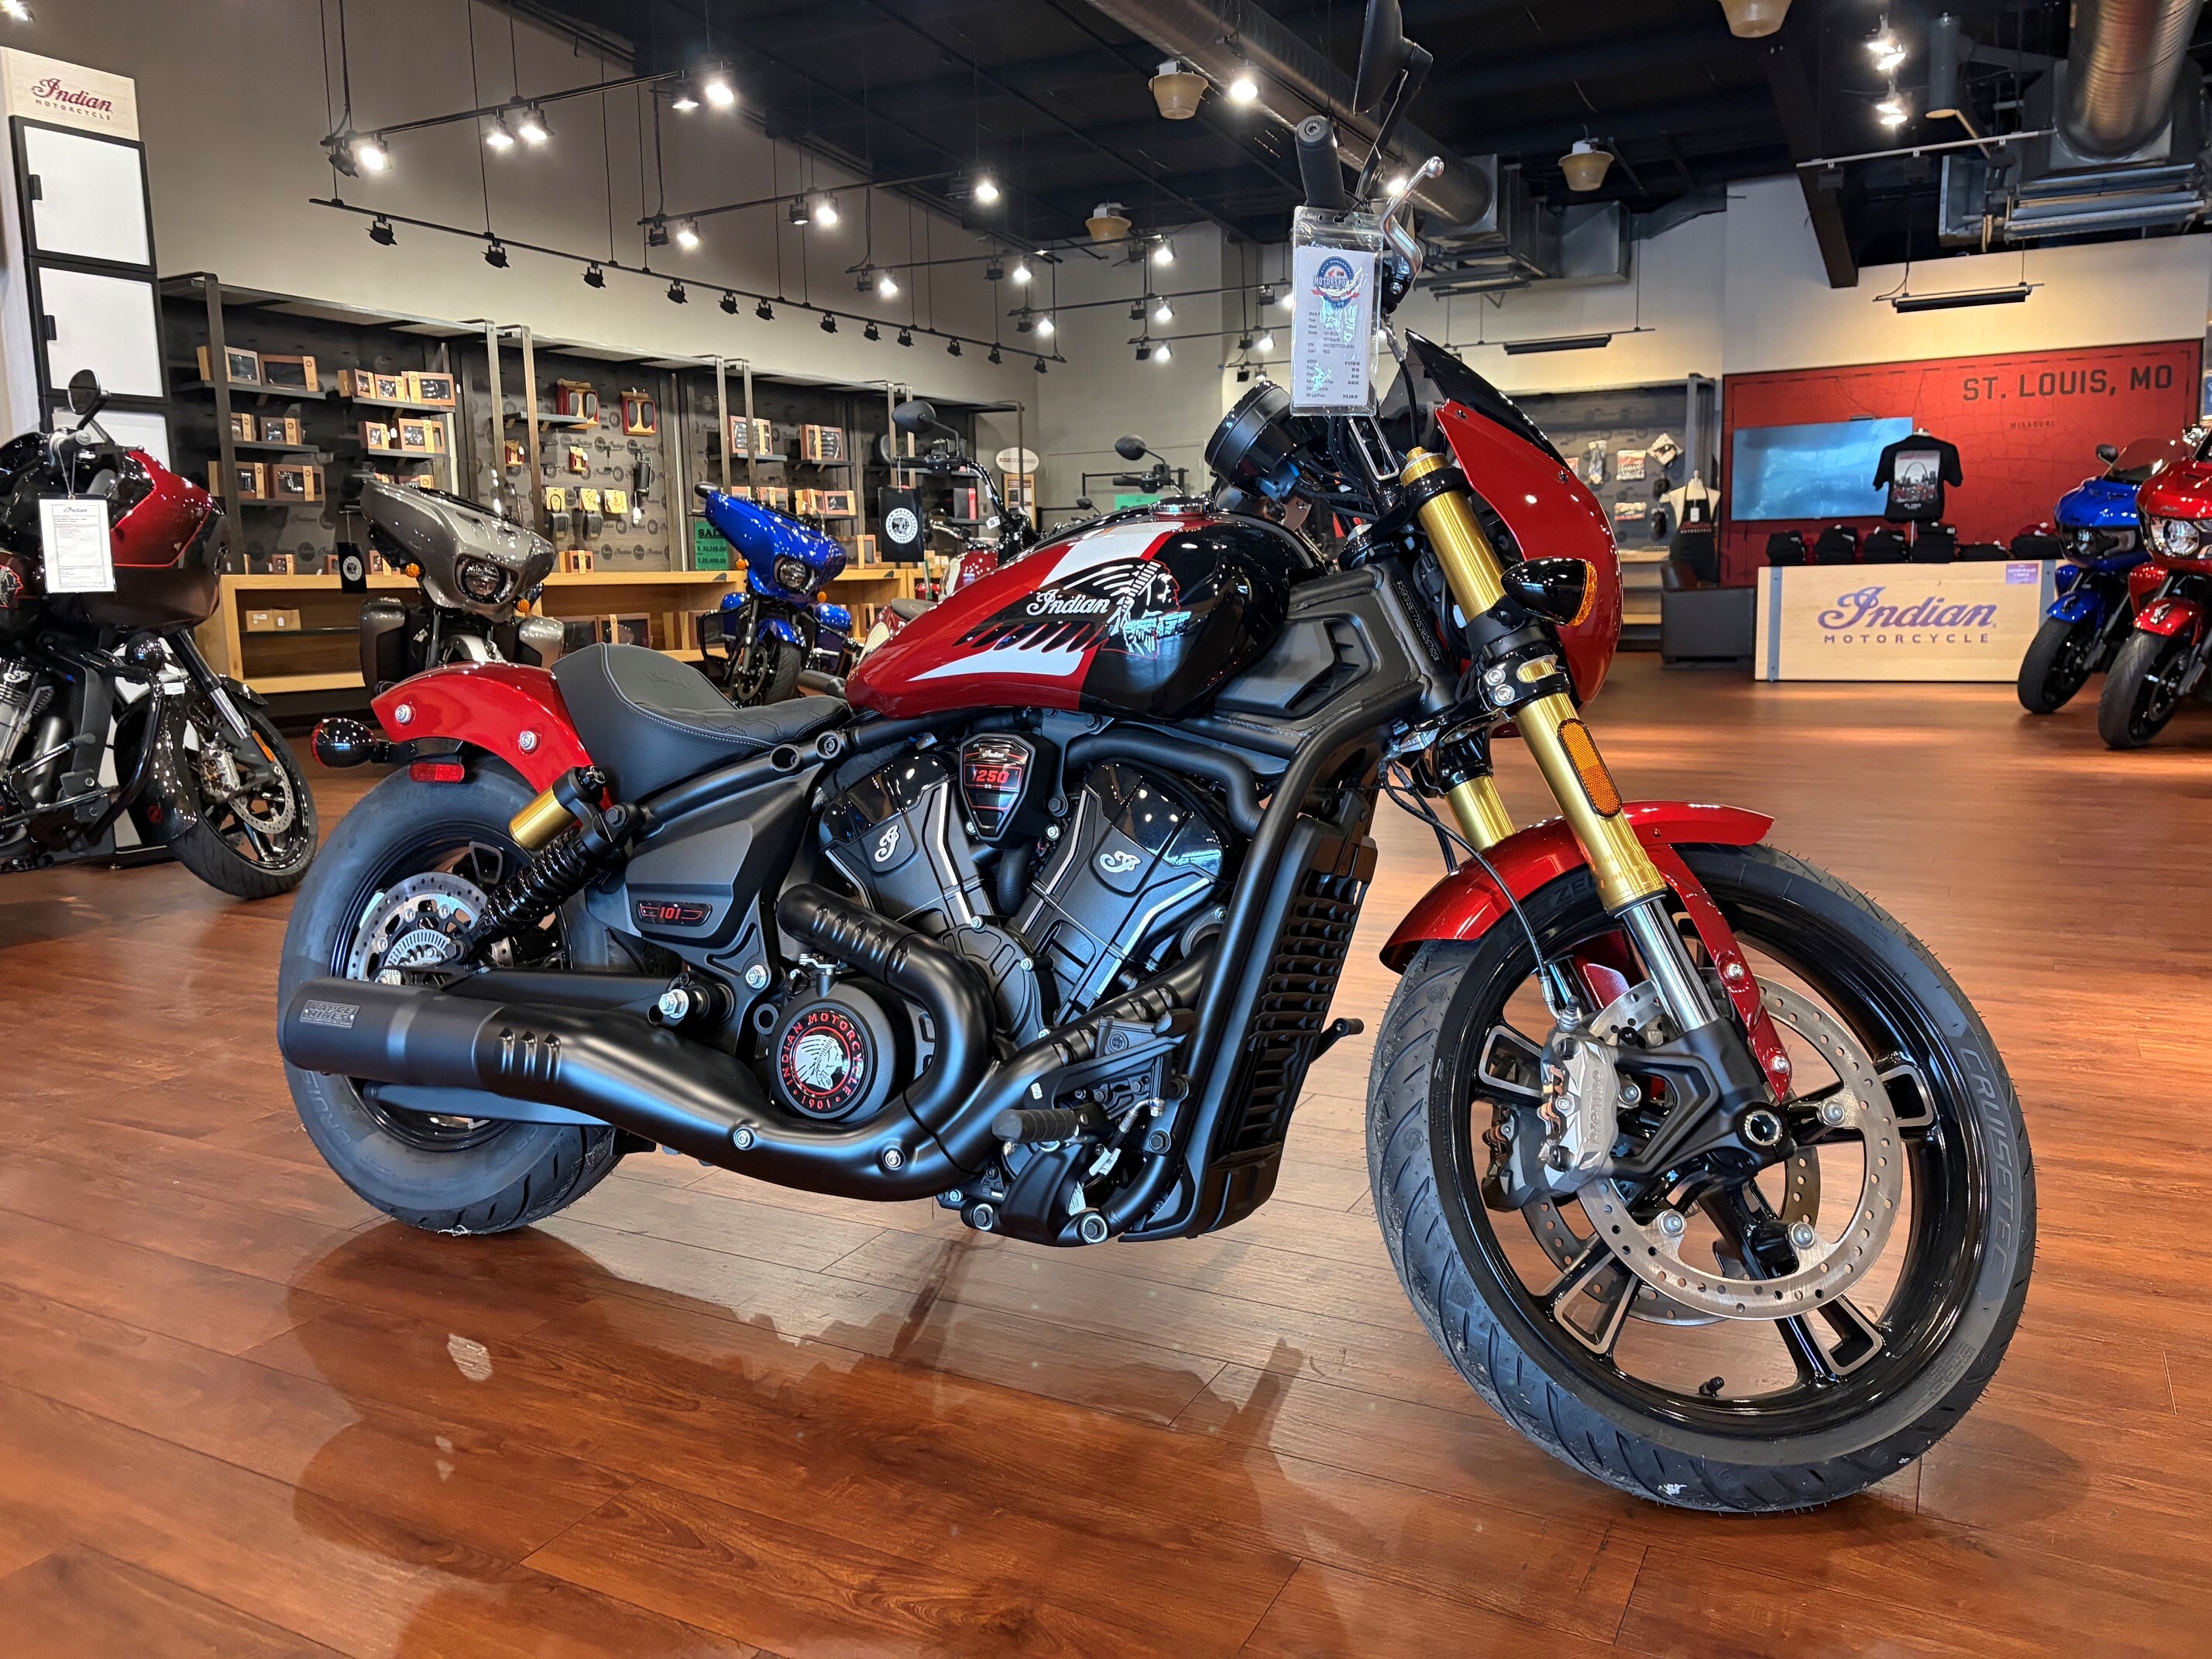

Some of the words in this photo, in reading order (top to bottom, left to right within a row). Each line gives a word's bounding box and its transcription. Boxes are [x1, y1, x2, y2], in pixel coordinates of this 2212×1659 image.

[31, 78, 112, 112] Indian
[35, 99, 111, 121] MOTORCYCLE
[1963, 376, 2007, 401] ST.
[2019, 369, 2116, 397] LOUIS,
[2130, 365, 2172, 390] MO
[698, 528, 720, 537] SAL
[1026, 589, 1110, 616] Indian
[1818, 586, 1997, 630] Indian
[1824, 633, 1988, 644] MOTORCYCLE
[982, 749, 1005, 758] Indian
[972, 769, 1010, 784] 1250
[659, 906, 681, 919] 101
[781, 1022, 803, 1086] INDIAN
[808, 1012, 863, 1095] MOTORCYCLE
[801, 1095, 832, 1109] 1901
[1587, 1069, 1603, 1144] brembo
[1960, 1048, 2014, 1276] CRUISETEC
